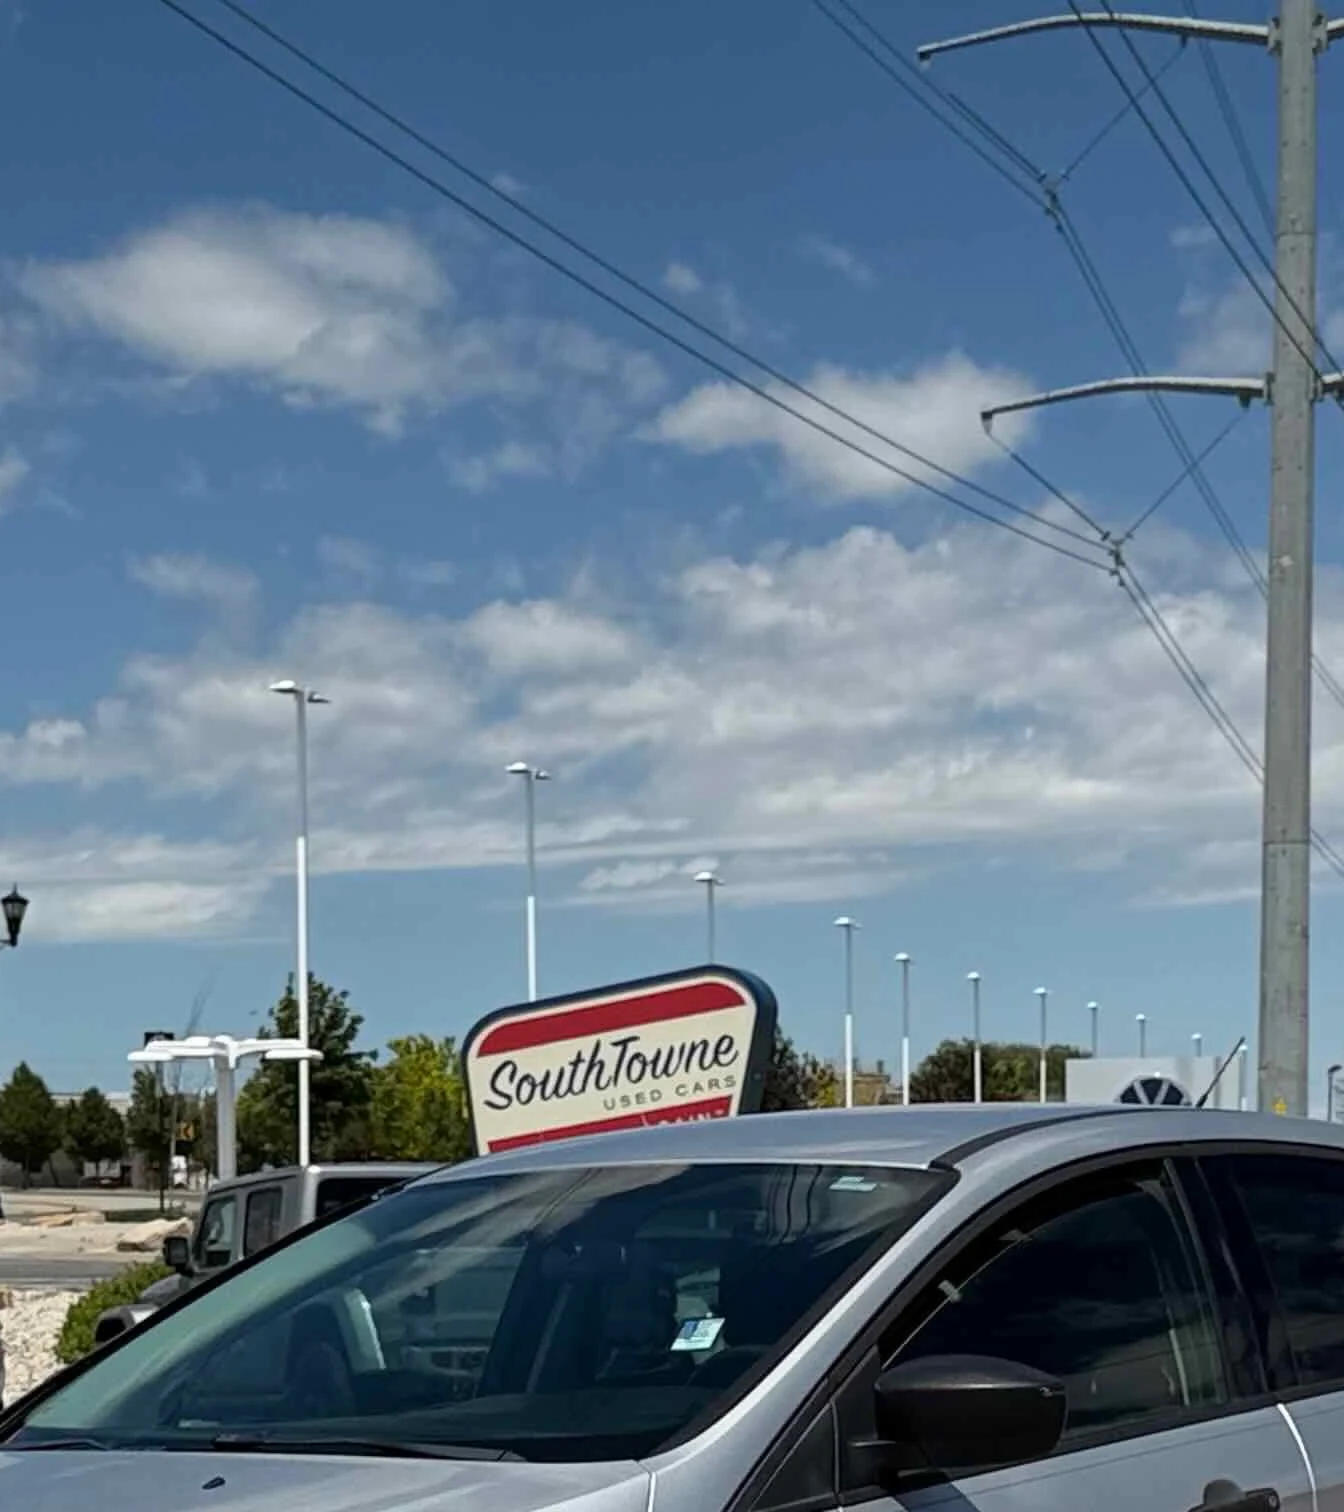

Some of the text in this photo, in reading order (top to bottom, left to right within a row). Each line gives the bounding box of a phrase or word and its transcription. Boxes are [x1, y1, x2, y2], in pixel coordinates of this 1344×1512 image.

[483, 1033, 740, 1111] SouthTowne
[603, 1074, 738, 1111] USED CARS
